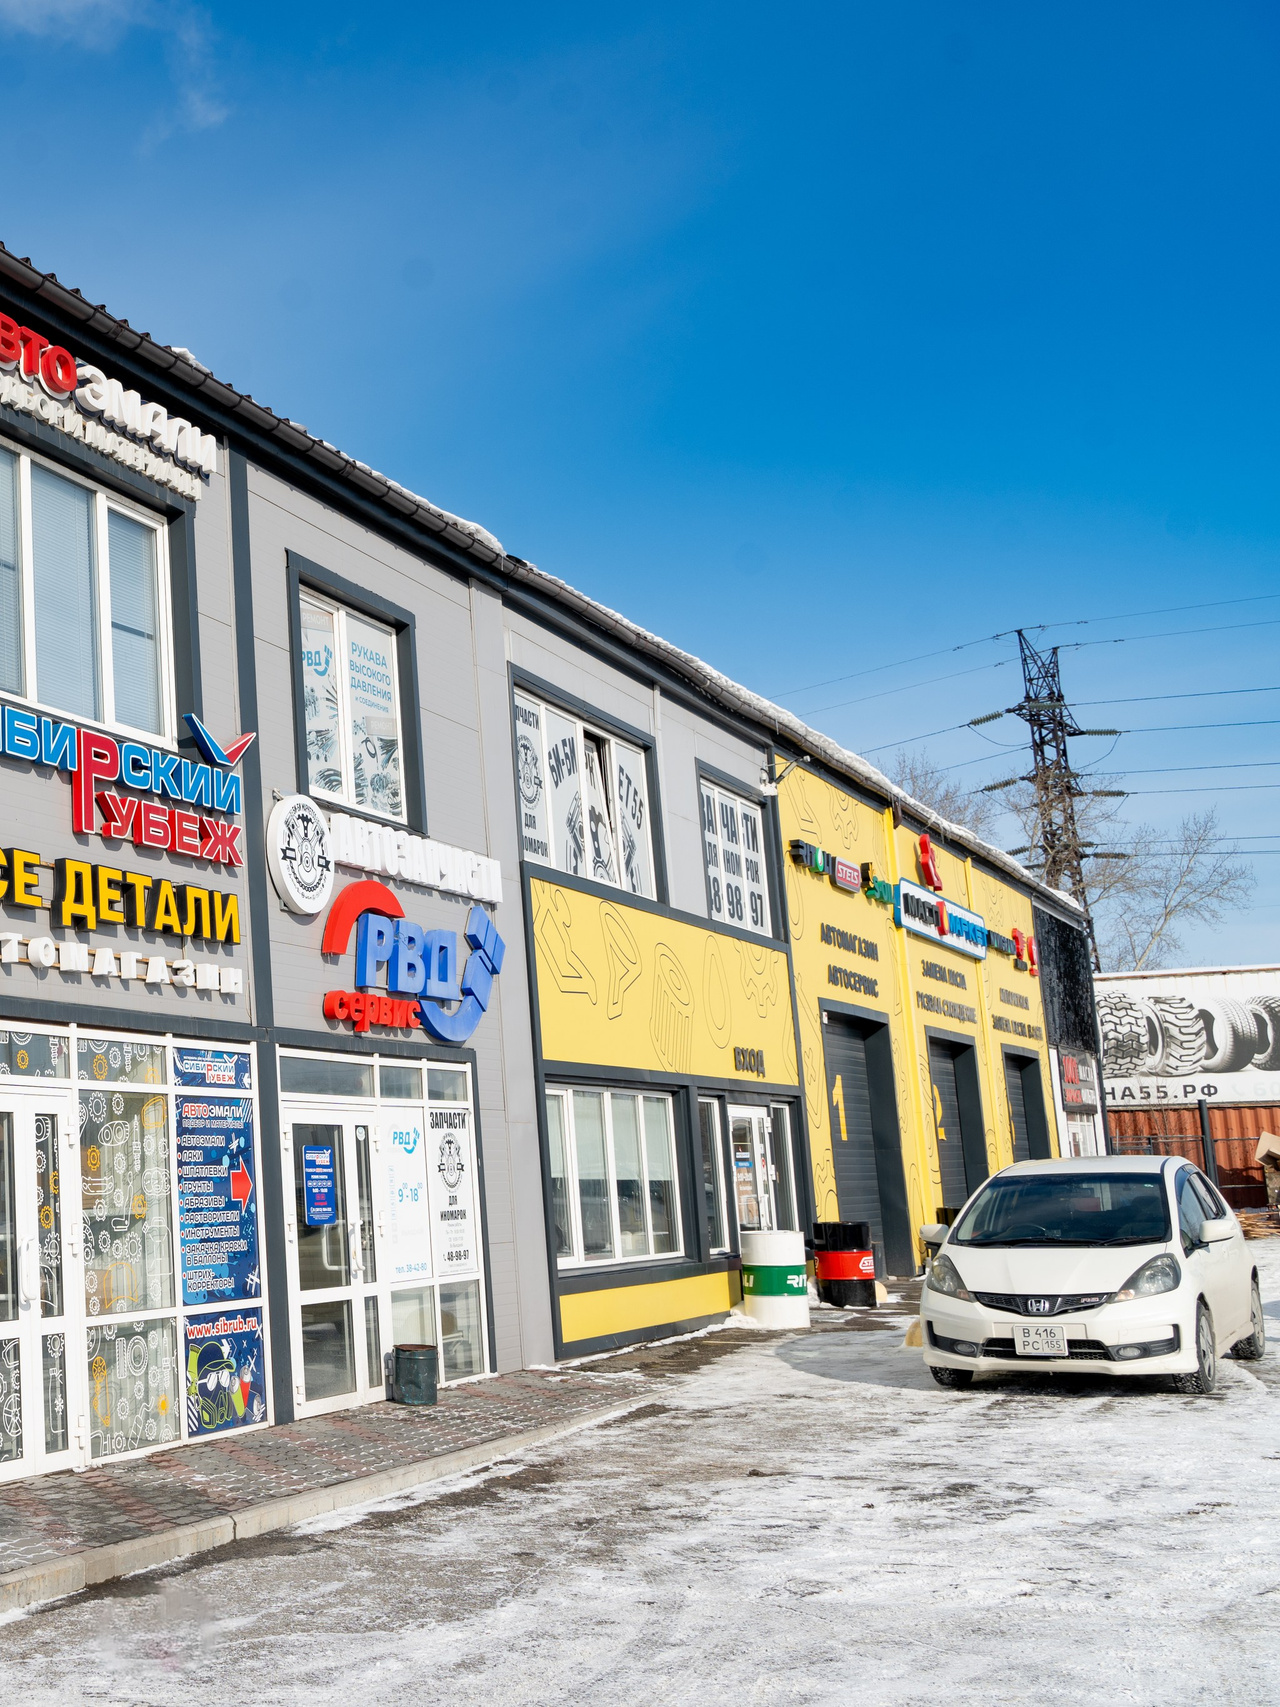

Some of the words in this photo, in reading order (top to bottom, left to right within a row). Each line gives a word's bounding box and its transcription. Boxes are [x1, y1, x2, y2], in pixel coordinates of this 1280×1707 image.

[351, 642, 387, 669] РУКАВА
[350, 660, 391, 686] ВЫСОКОГО
[351, 677, 392, 702] ДАВЛЕНИЯ
[547, 737, 578, 789] БИ-БИ
[525, 812, 536, 830] ДЛЯ
[331, 813, 503, 903] АВТОЗАПЧАСТИ
[51, 857, 241, 945] ДЕТАЛИ
[821, 922, 879, 962] АВТОМАГАЗИН
[356, 913, 460, 1000] РВД
[828, 964, 879, 998] АВТОСЕРВИС
[324, 989, 421, 1031] сервис
[733, 1046, 766, 1078] ВХОД
[1103, 1083, 1218, 1101] НА55.РФ
[182, 1104, 243, 1118] АВТОЭМАЛИ
[832, 1074, 848, 1141] 1
[182, 1118, 206, 1128] ПОДБОР
[430, 1112, 466, 1129] ЗАПЧАСТИ
[181, 1136, 225, 1146] АВТОЭМАЛИ
[393, 1131, 411, 1145] РВД
[182, 1150, 203, 1161] ЛАКИ
[182, 1166, 228, 1177] ШПАТЛЕВКИ
[183, 1181, 213, 1192] ГРУНТЫ
[184, 1196, 225, 1208] АБРАЗИВЫ
[449, 1195, 457, 1206] ДЛЯ
[184, 1211, 240, 1224] РАСТВОРИТЕЛИ
[440, 1209, 466, 1221] ИНОМАРОК
[185, 1225, 240, 1239] ИНСТРУМЕНТЫ
[186, 1242, 220, 1254] ЗАКАЧКА
[220, 1240, 248, 1252] КРАСКИ
[186, 1255, 192, 1266] В
[193, 1253, 228, 1265] БАЛЛОНЫ
[447, 1250, 469, 1262] 48-98-97
[187, 1269, 215, 1280] ШТРИХ-
[187, 1277, 234, 1292] КОРРЕКТОРЫ
[187, 1315, 259, 1339] www.sibrub.ru
[1035, 1328, 1056, 1338] 416
[1044, 1341, 1061, 1349] 155
